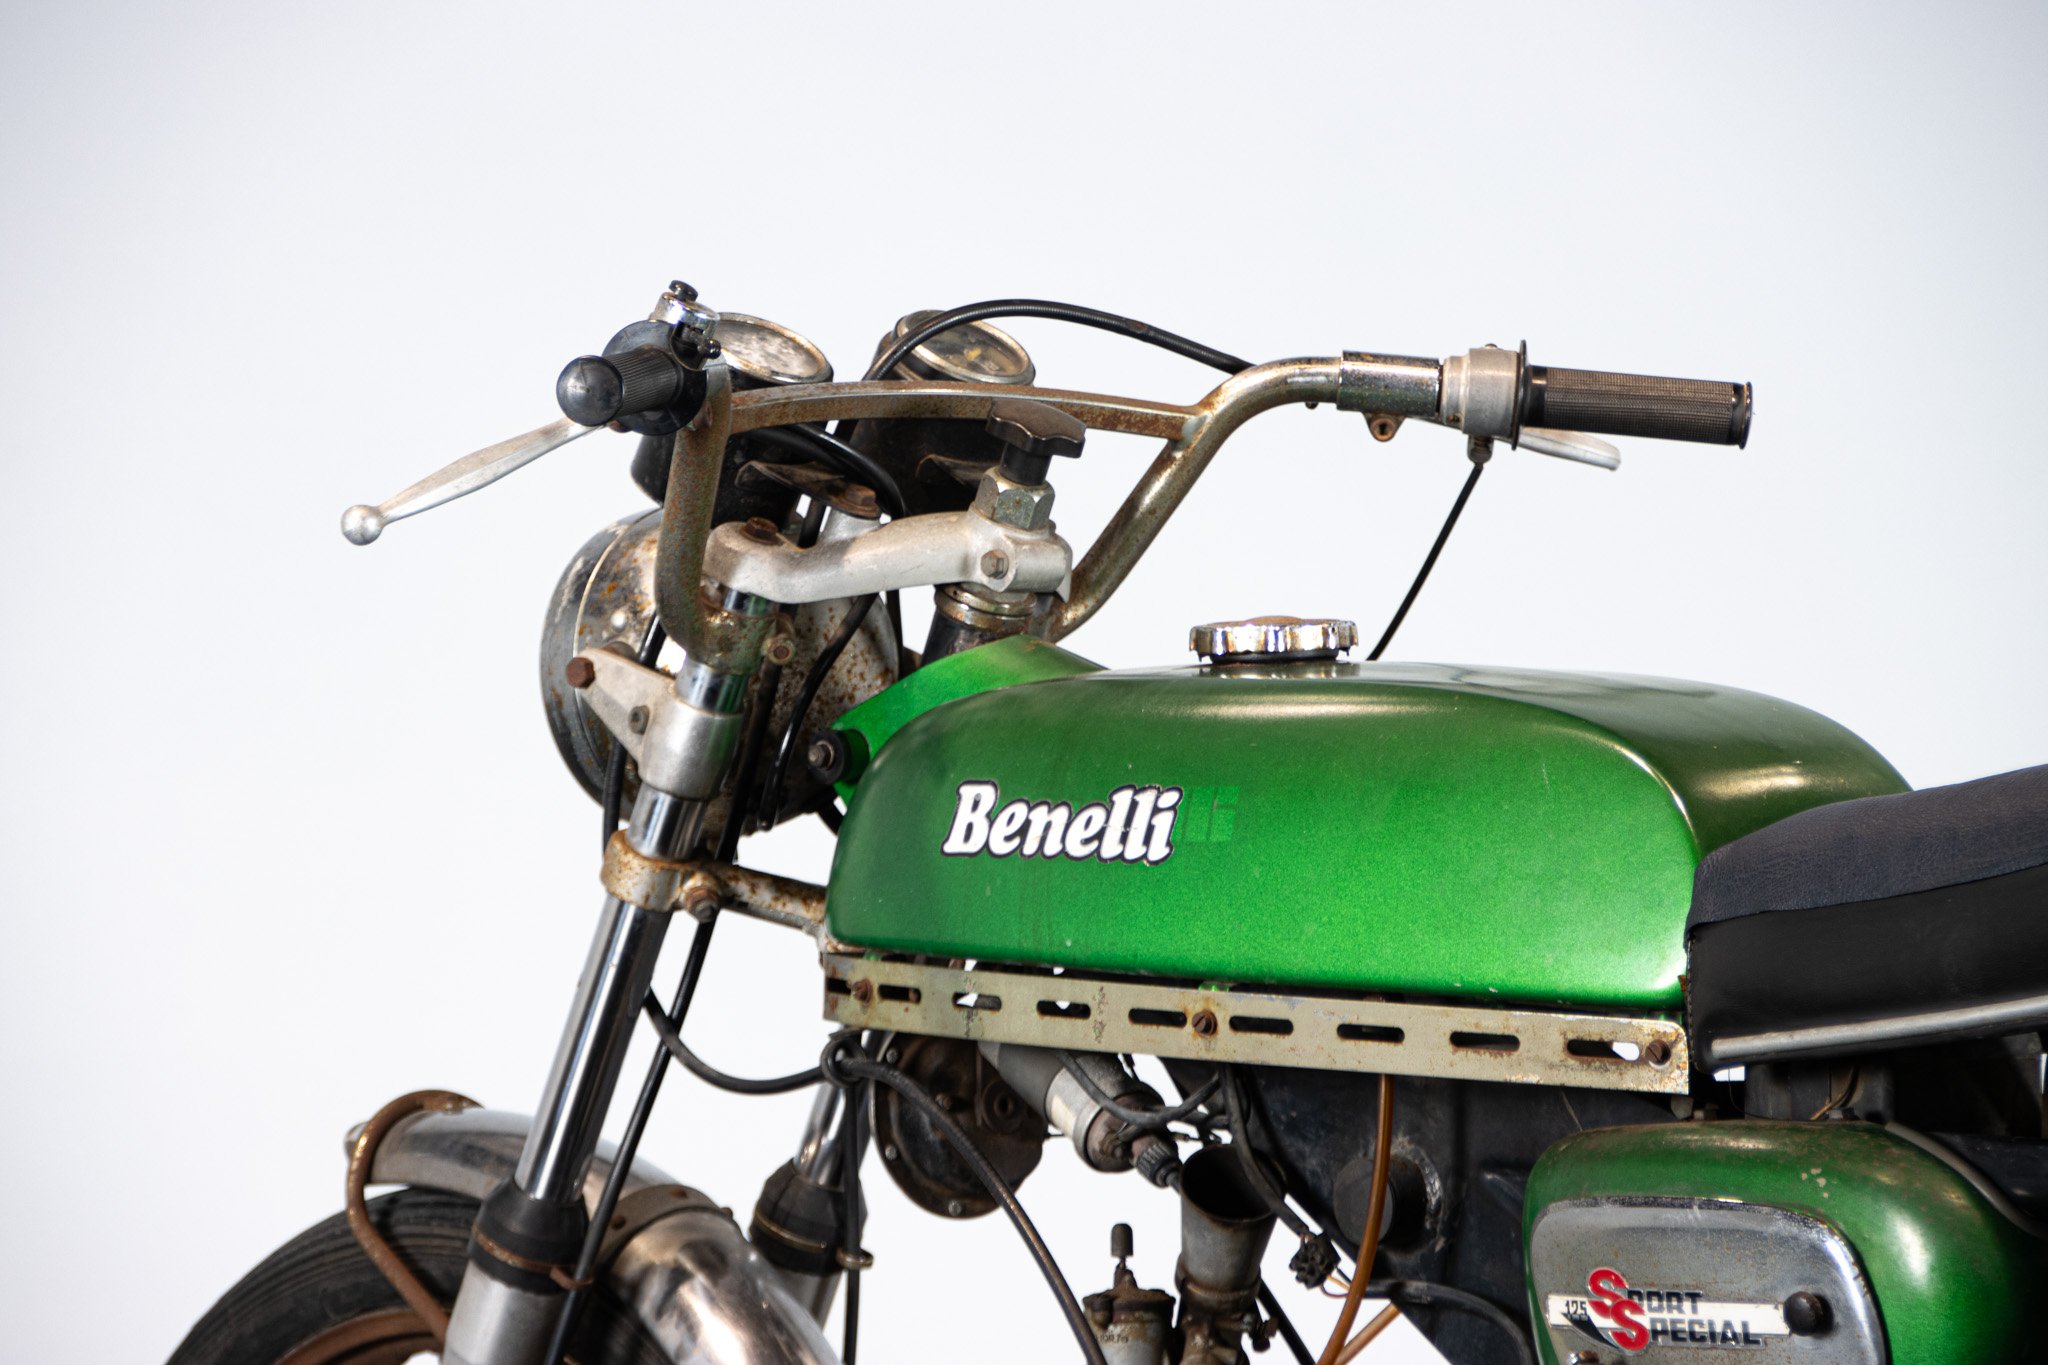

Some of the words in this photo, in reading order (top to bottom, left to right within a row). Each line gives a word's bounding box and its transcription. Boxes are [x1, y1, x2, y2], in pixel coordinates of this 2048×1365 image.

[942, 780, 1183, 865] Benelli
[1565, 1300, 1588, 1320] 125
[1609, 1298, 1761, 1351] SPECIAL
